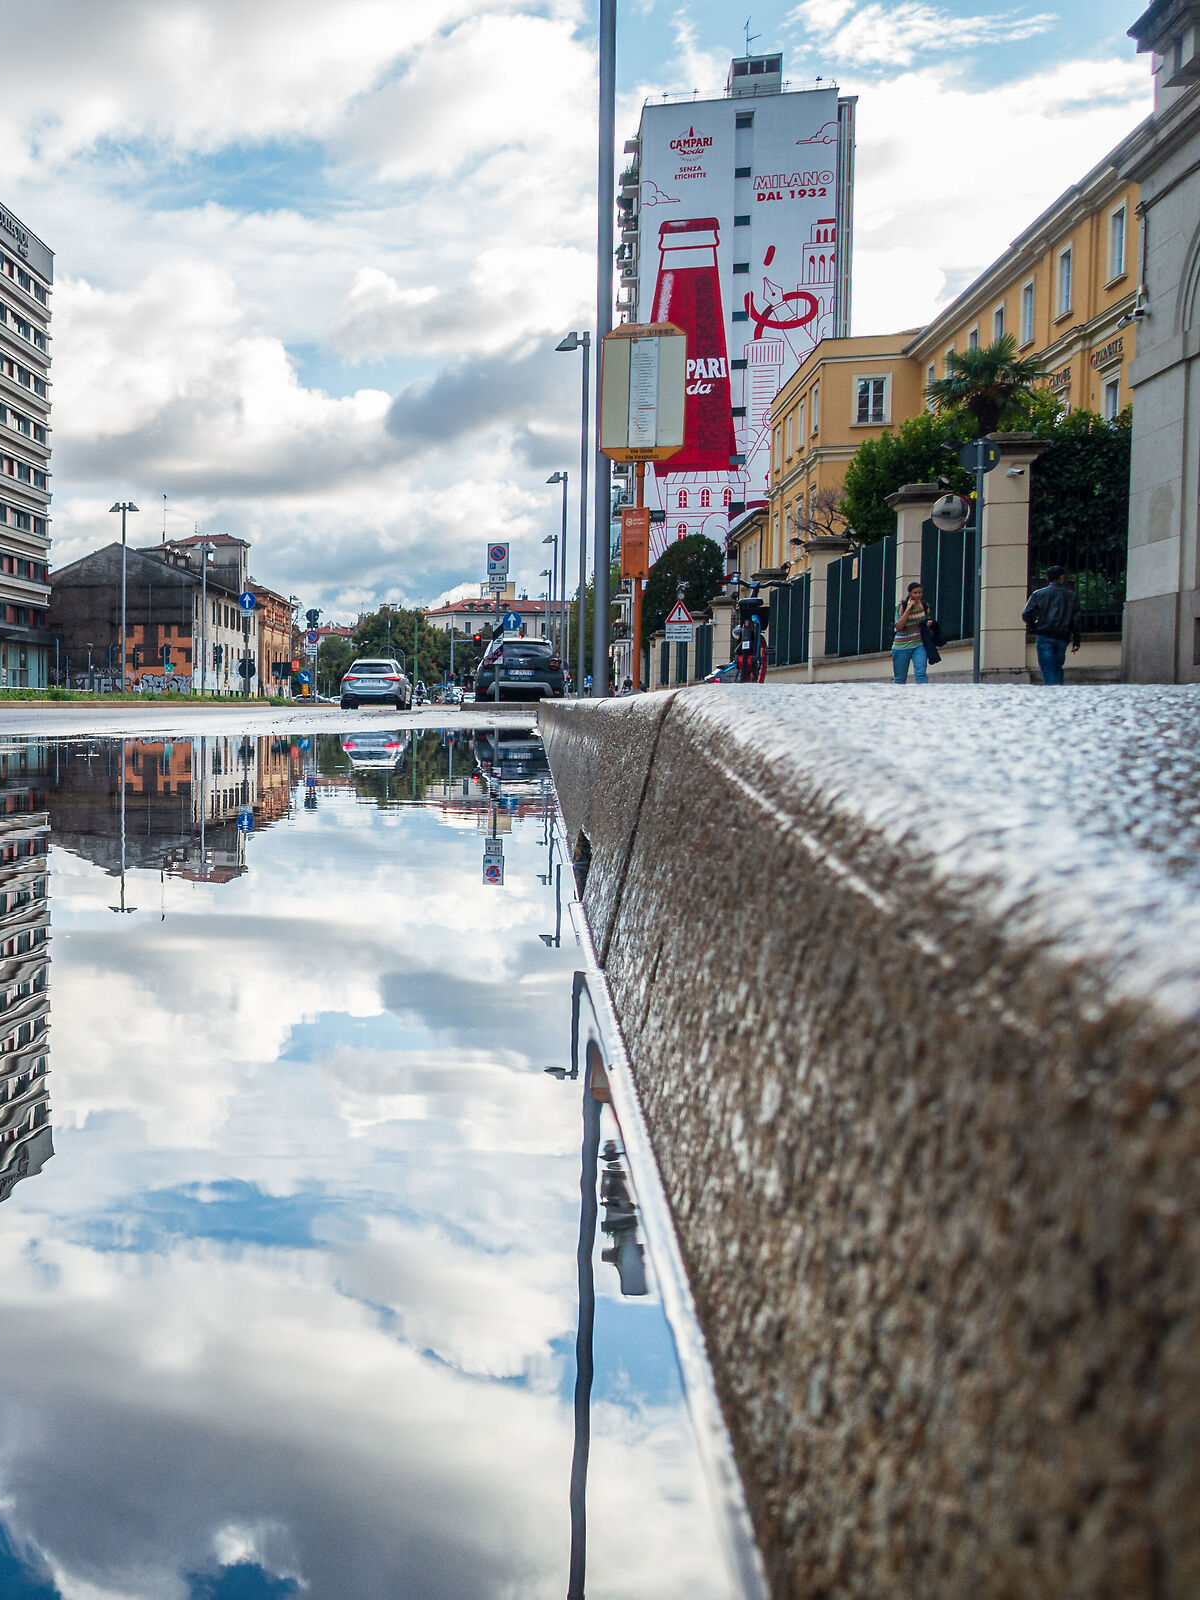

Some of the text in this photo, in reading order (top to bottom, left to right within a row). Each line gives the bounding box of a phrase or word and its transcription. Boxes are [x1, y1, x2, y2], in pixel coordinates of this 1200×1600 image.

[670, 137, 713, 150] CAMPARI
[677, 148, 705, 156] Soda
[674, 172, 707, 180] ETICHETTE
[753, 170, 835, 190] MILANO
[757, 187, 827, 202] DAL 1932
[686, 357, 727, 380] PARI
[686, 380, 712, 395] da
